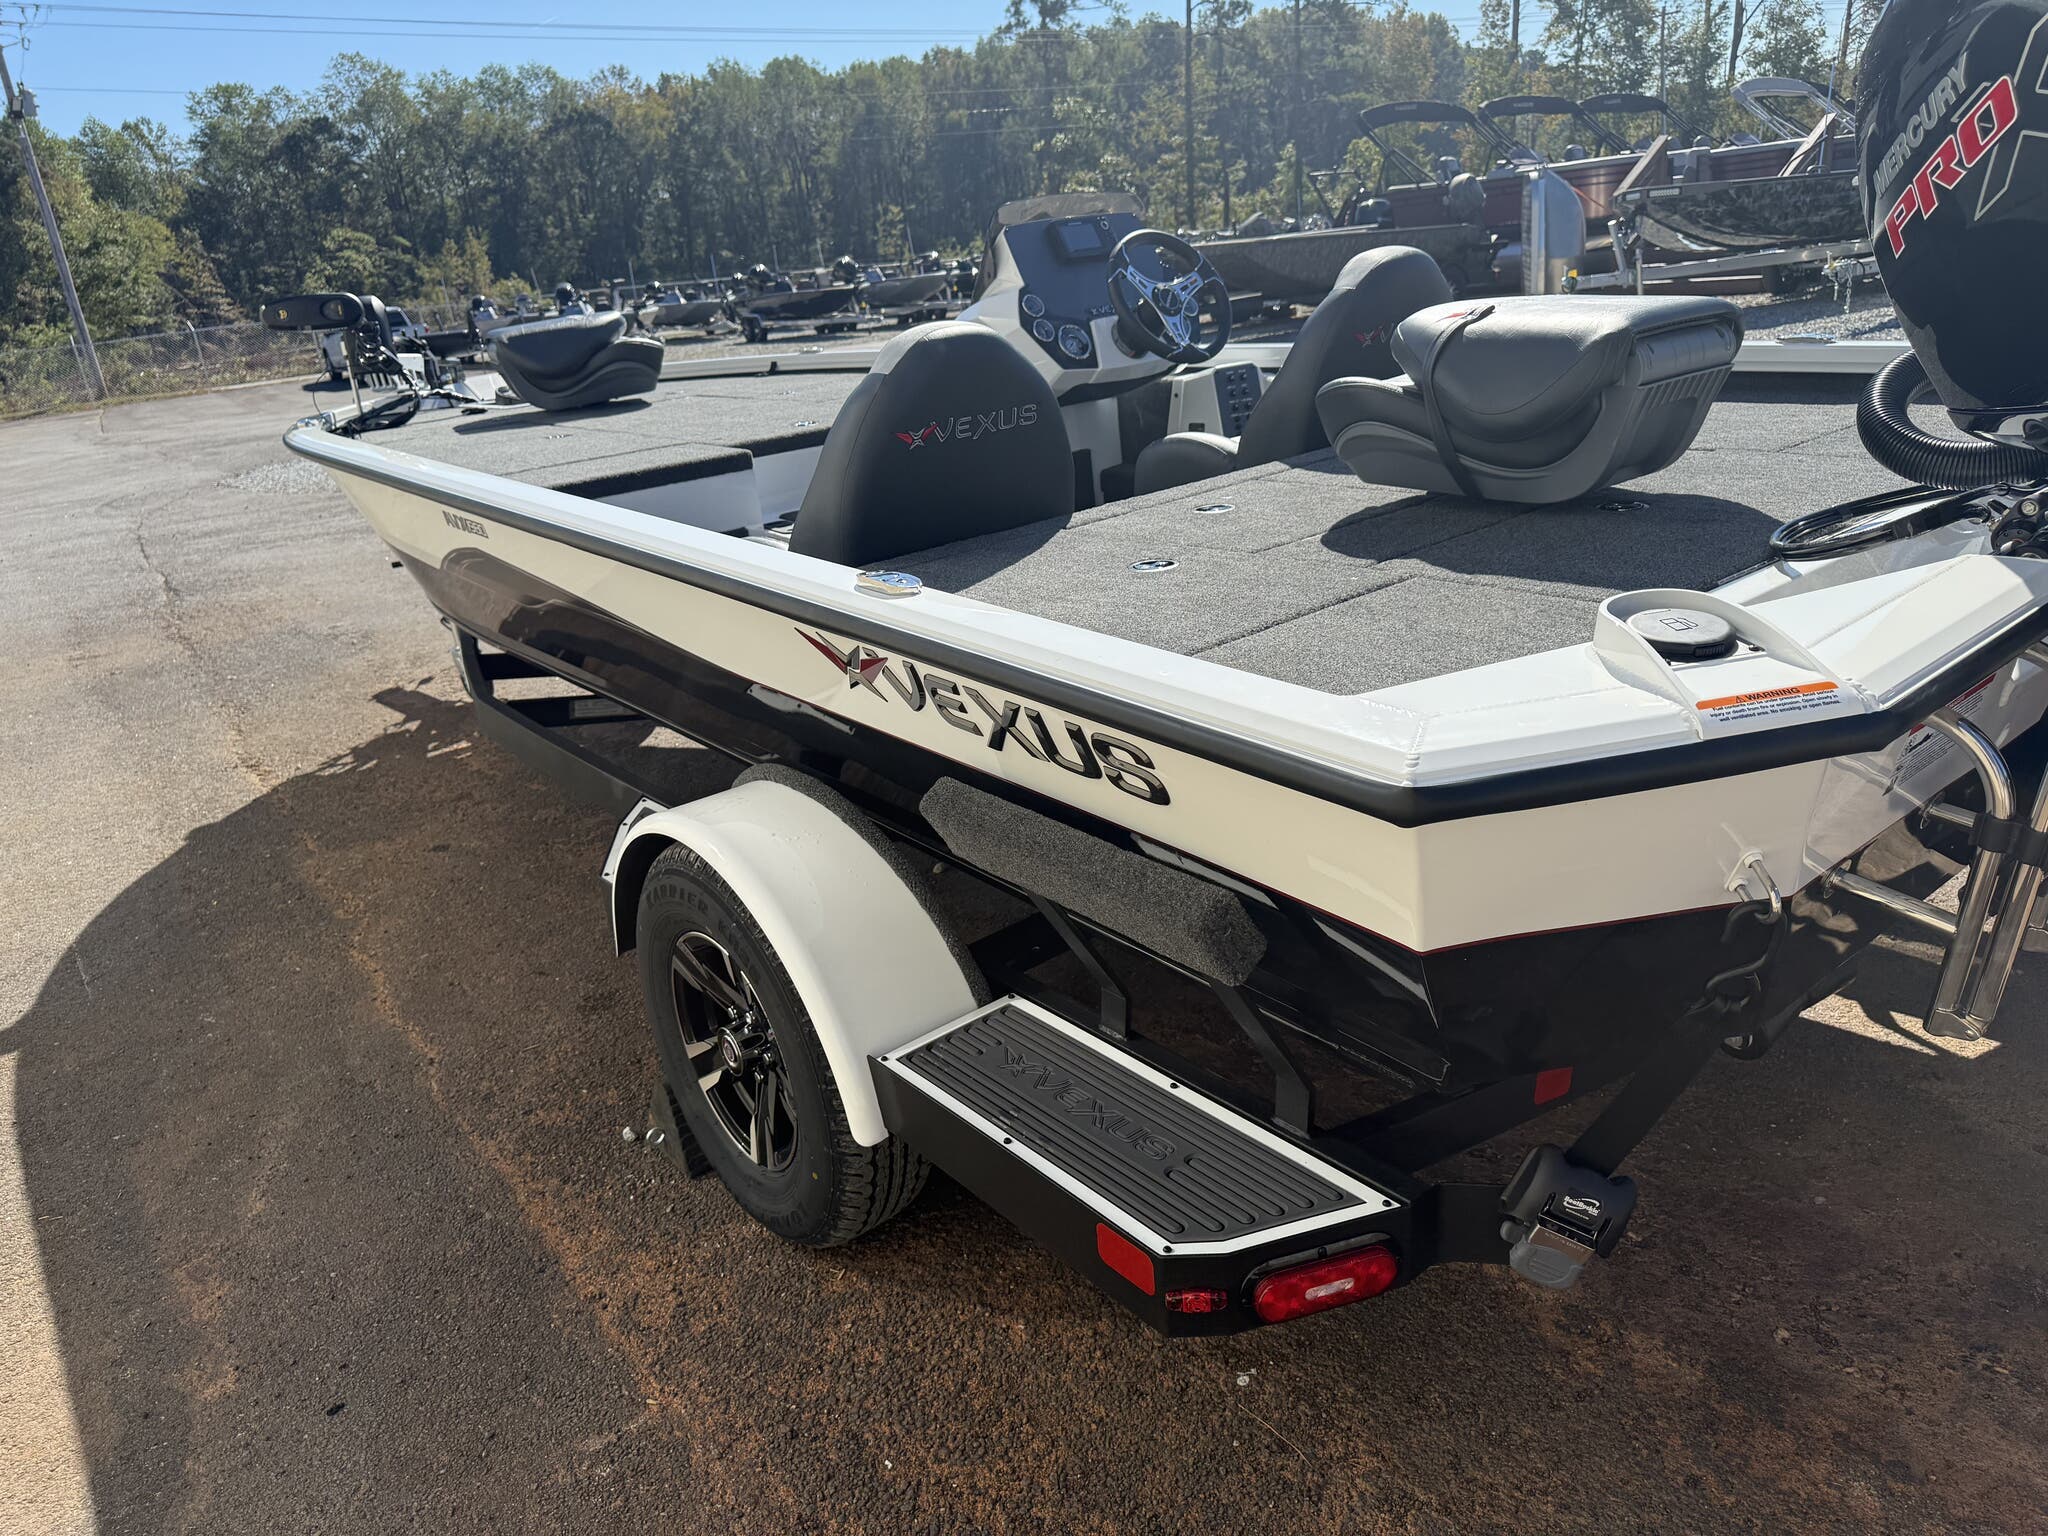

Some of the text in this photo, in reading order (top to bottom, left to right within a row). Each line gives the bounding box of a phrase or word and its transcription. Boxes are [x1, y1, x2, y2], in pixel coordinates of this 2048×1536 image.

[1873, 52, 1968, 201] MERCURY
[1884, 74, 2018, 260] PRO
[930, 403, 1037, 443] VEXUS
[862, 647, 1171, 806] VEXUS
[1745, 687, 1800, 701] WARNING
[1033, 1064, 1176, 1160] VEXUS
